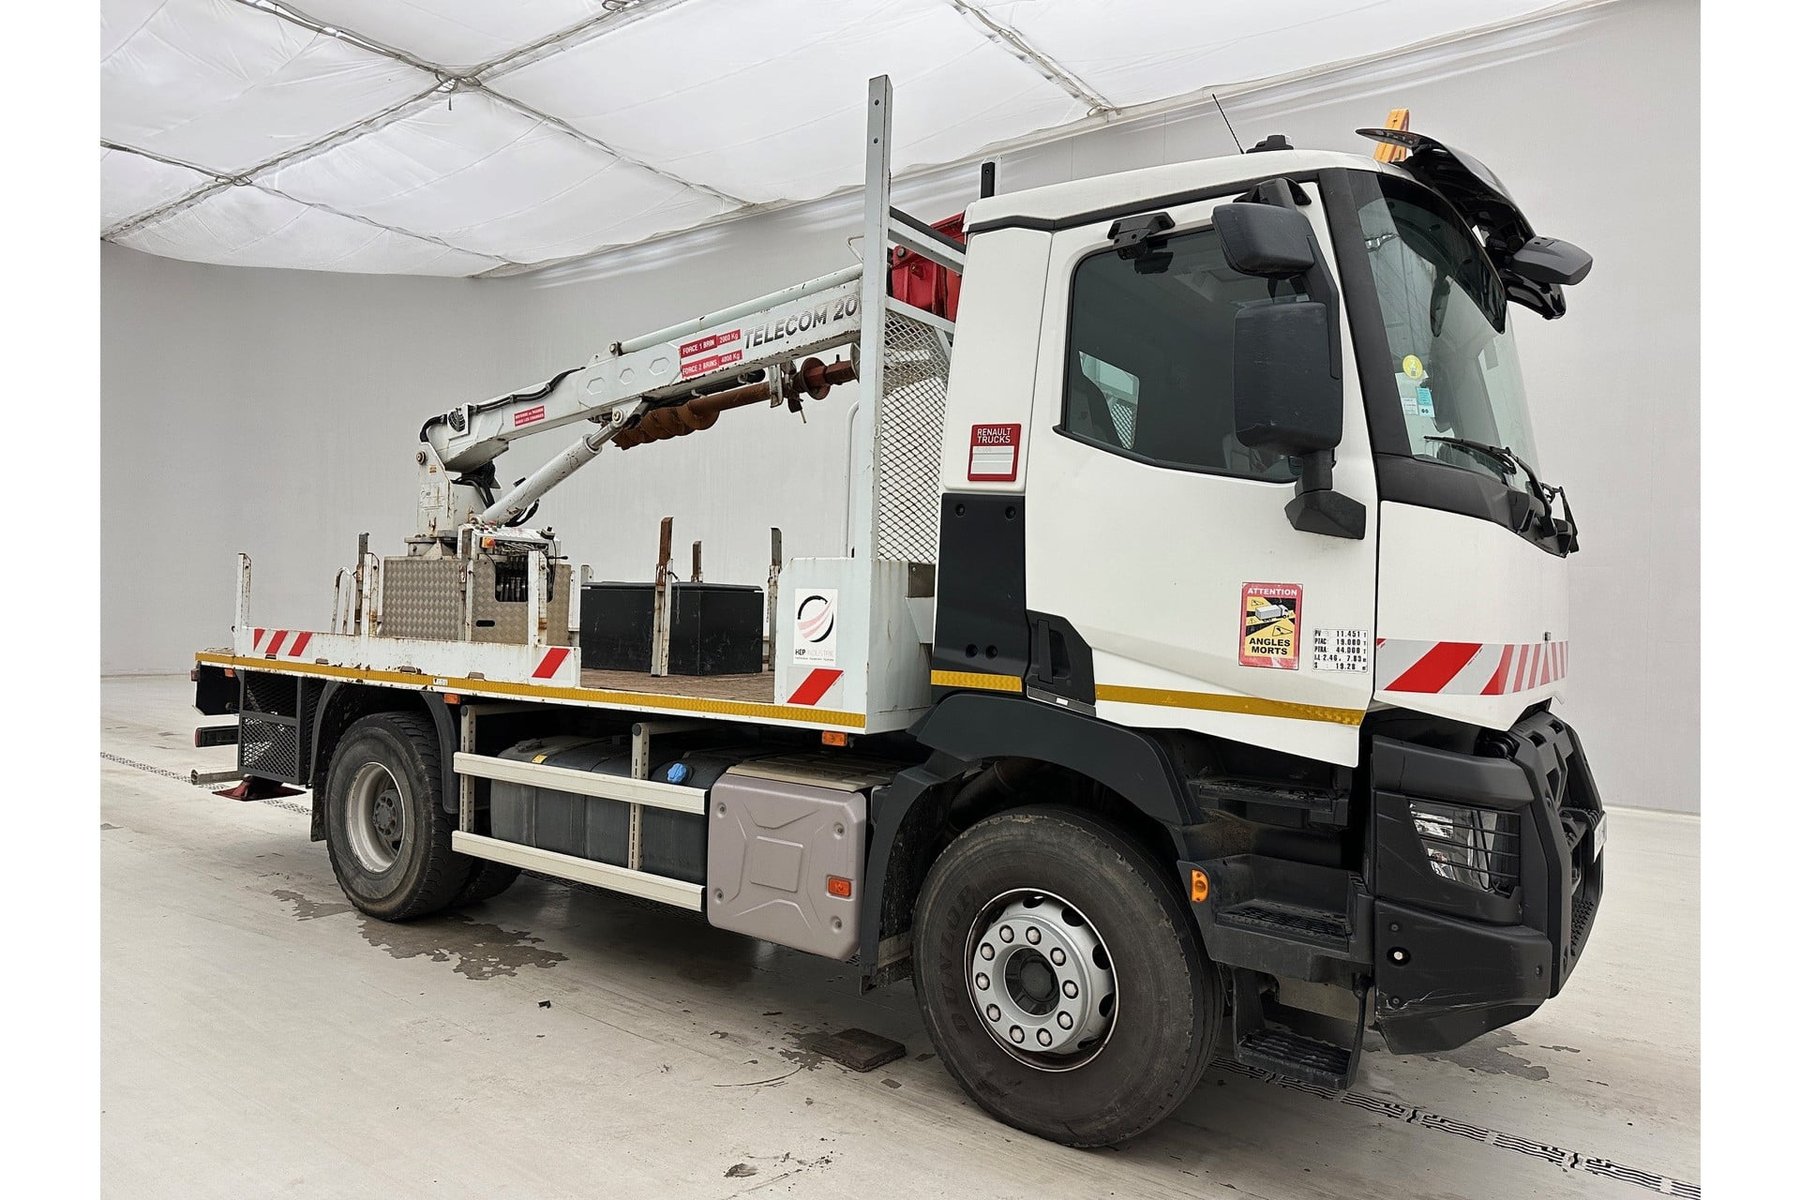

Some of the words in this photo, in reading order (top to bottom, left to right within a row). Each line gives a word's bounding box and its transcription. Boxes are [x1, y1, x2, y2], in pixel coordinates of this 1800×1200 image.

[744, 306, 828, 349] TELECOM
[833, 297, 858, 321] 20
[682, 344, 698, 355] FORCE
[703, 339, 715, 348] BRIN
[731, 331, 738, 341] Kg
[682, 365, 698, 375] FORCE
[703, 359, 718, 369] BRINS
[977, 428, 1012, 436] RENAULT
[977, 435, 1011, 443] TRUCKS
[1247, 587, 1298, 596] ATTENTION
[1249, 637, 1291, 647] ANGLES
[1251, 646, 1288, 655] MORTS
